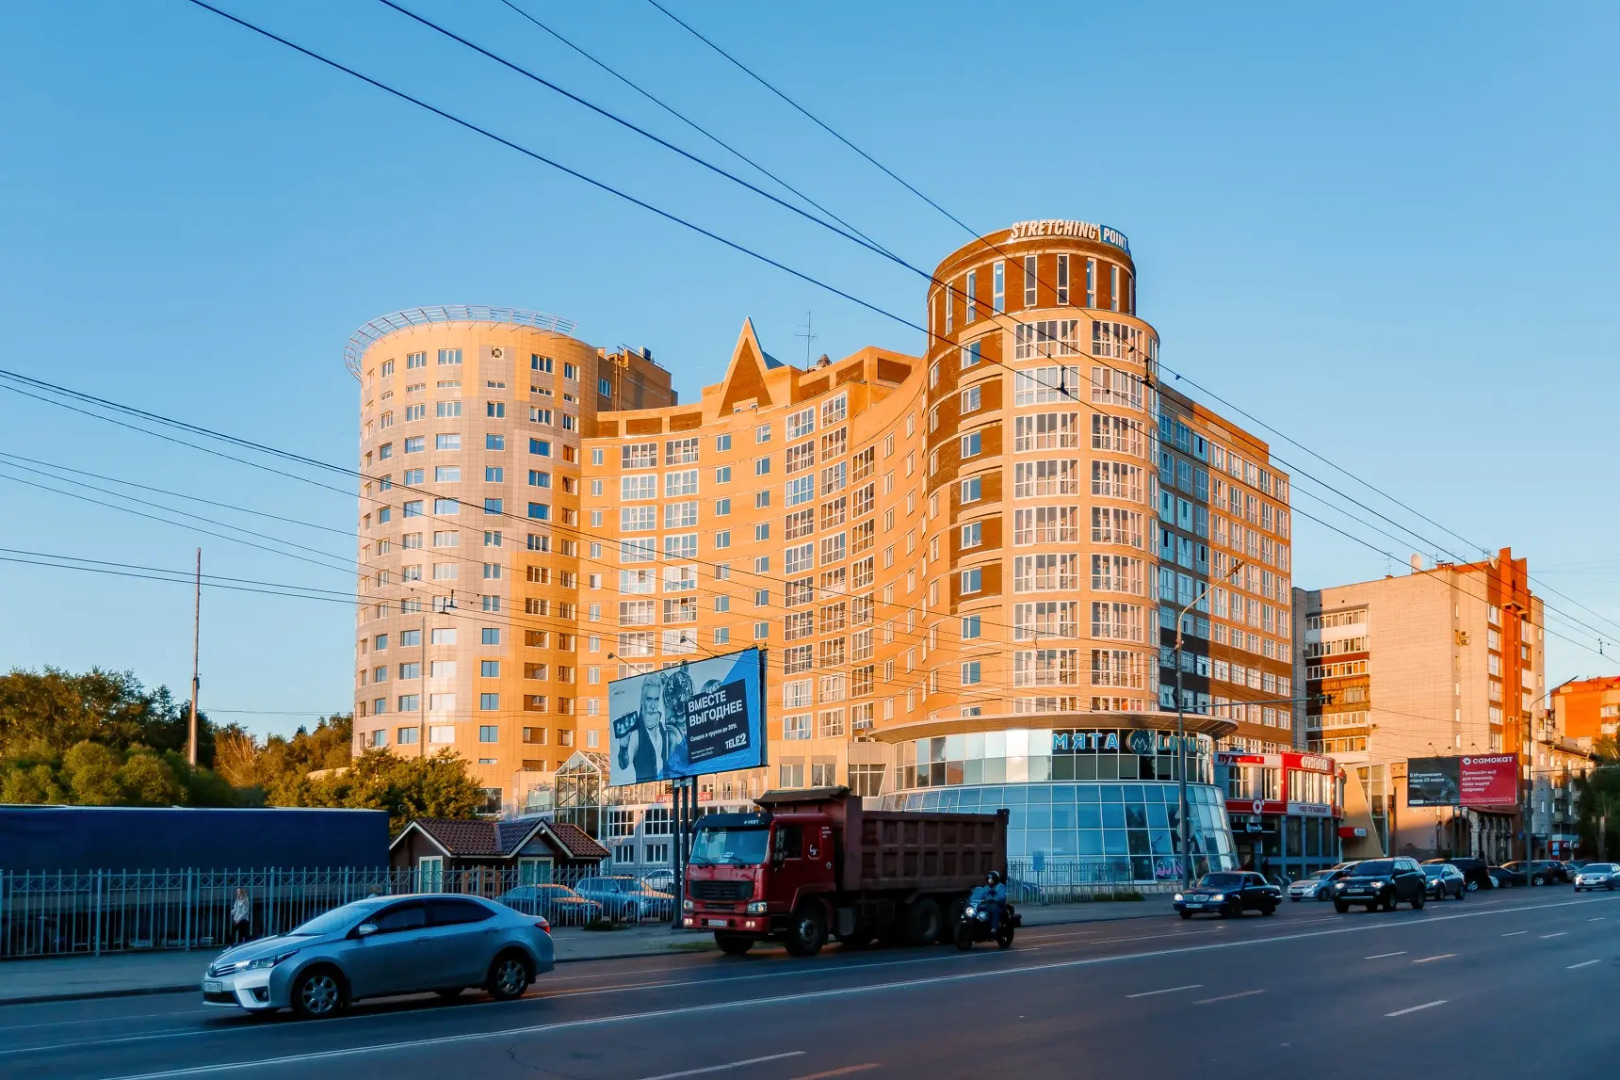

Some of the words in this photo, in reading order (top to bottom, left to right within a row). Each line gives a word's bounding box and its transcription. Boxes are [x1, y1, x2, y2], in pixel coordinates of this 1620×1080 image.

[1011, 219, 1096, 239] STRETCHING
[1103, 227, 1128, 249] POINT
[688, 690, 726, 713] ВМЕСТЕ
[689, 700, 743, 726] ВЫГОДНЕЕ
[725, 733, 747, 749] TELE2
[1052, 733, 1118, 749] МЯТА
